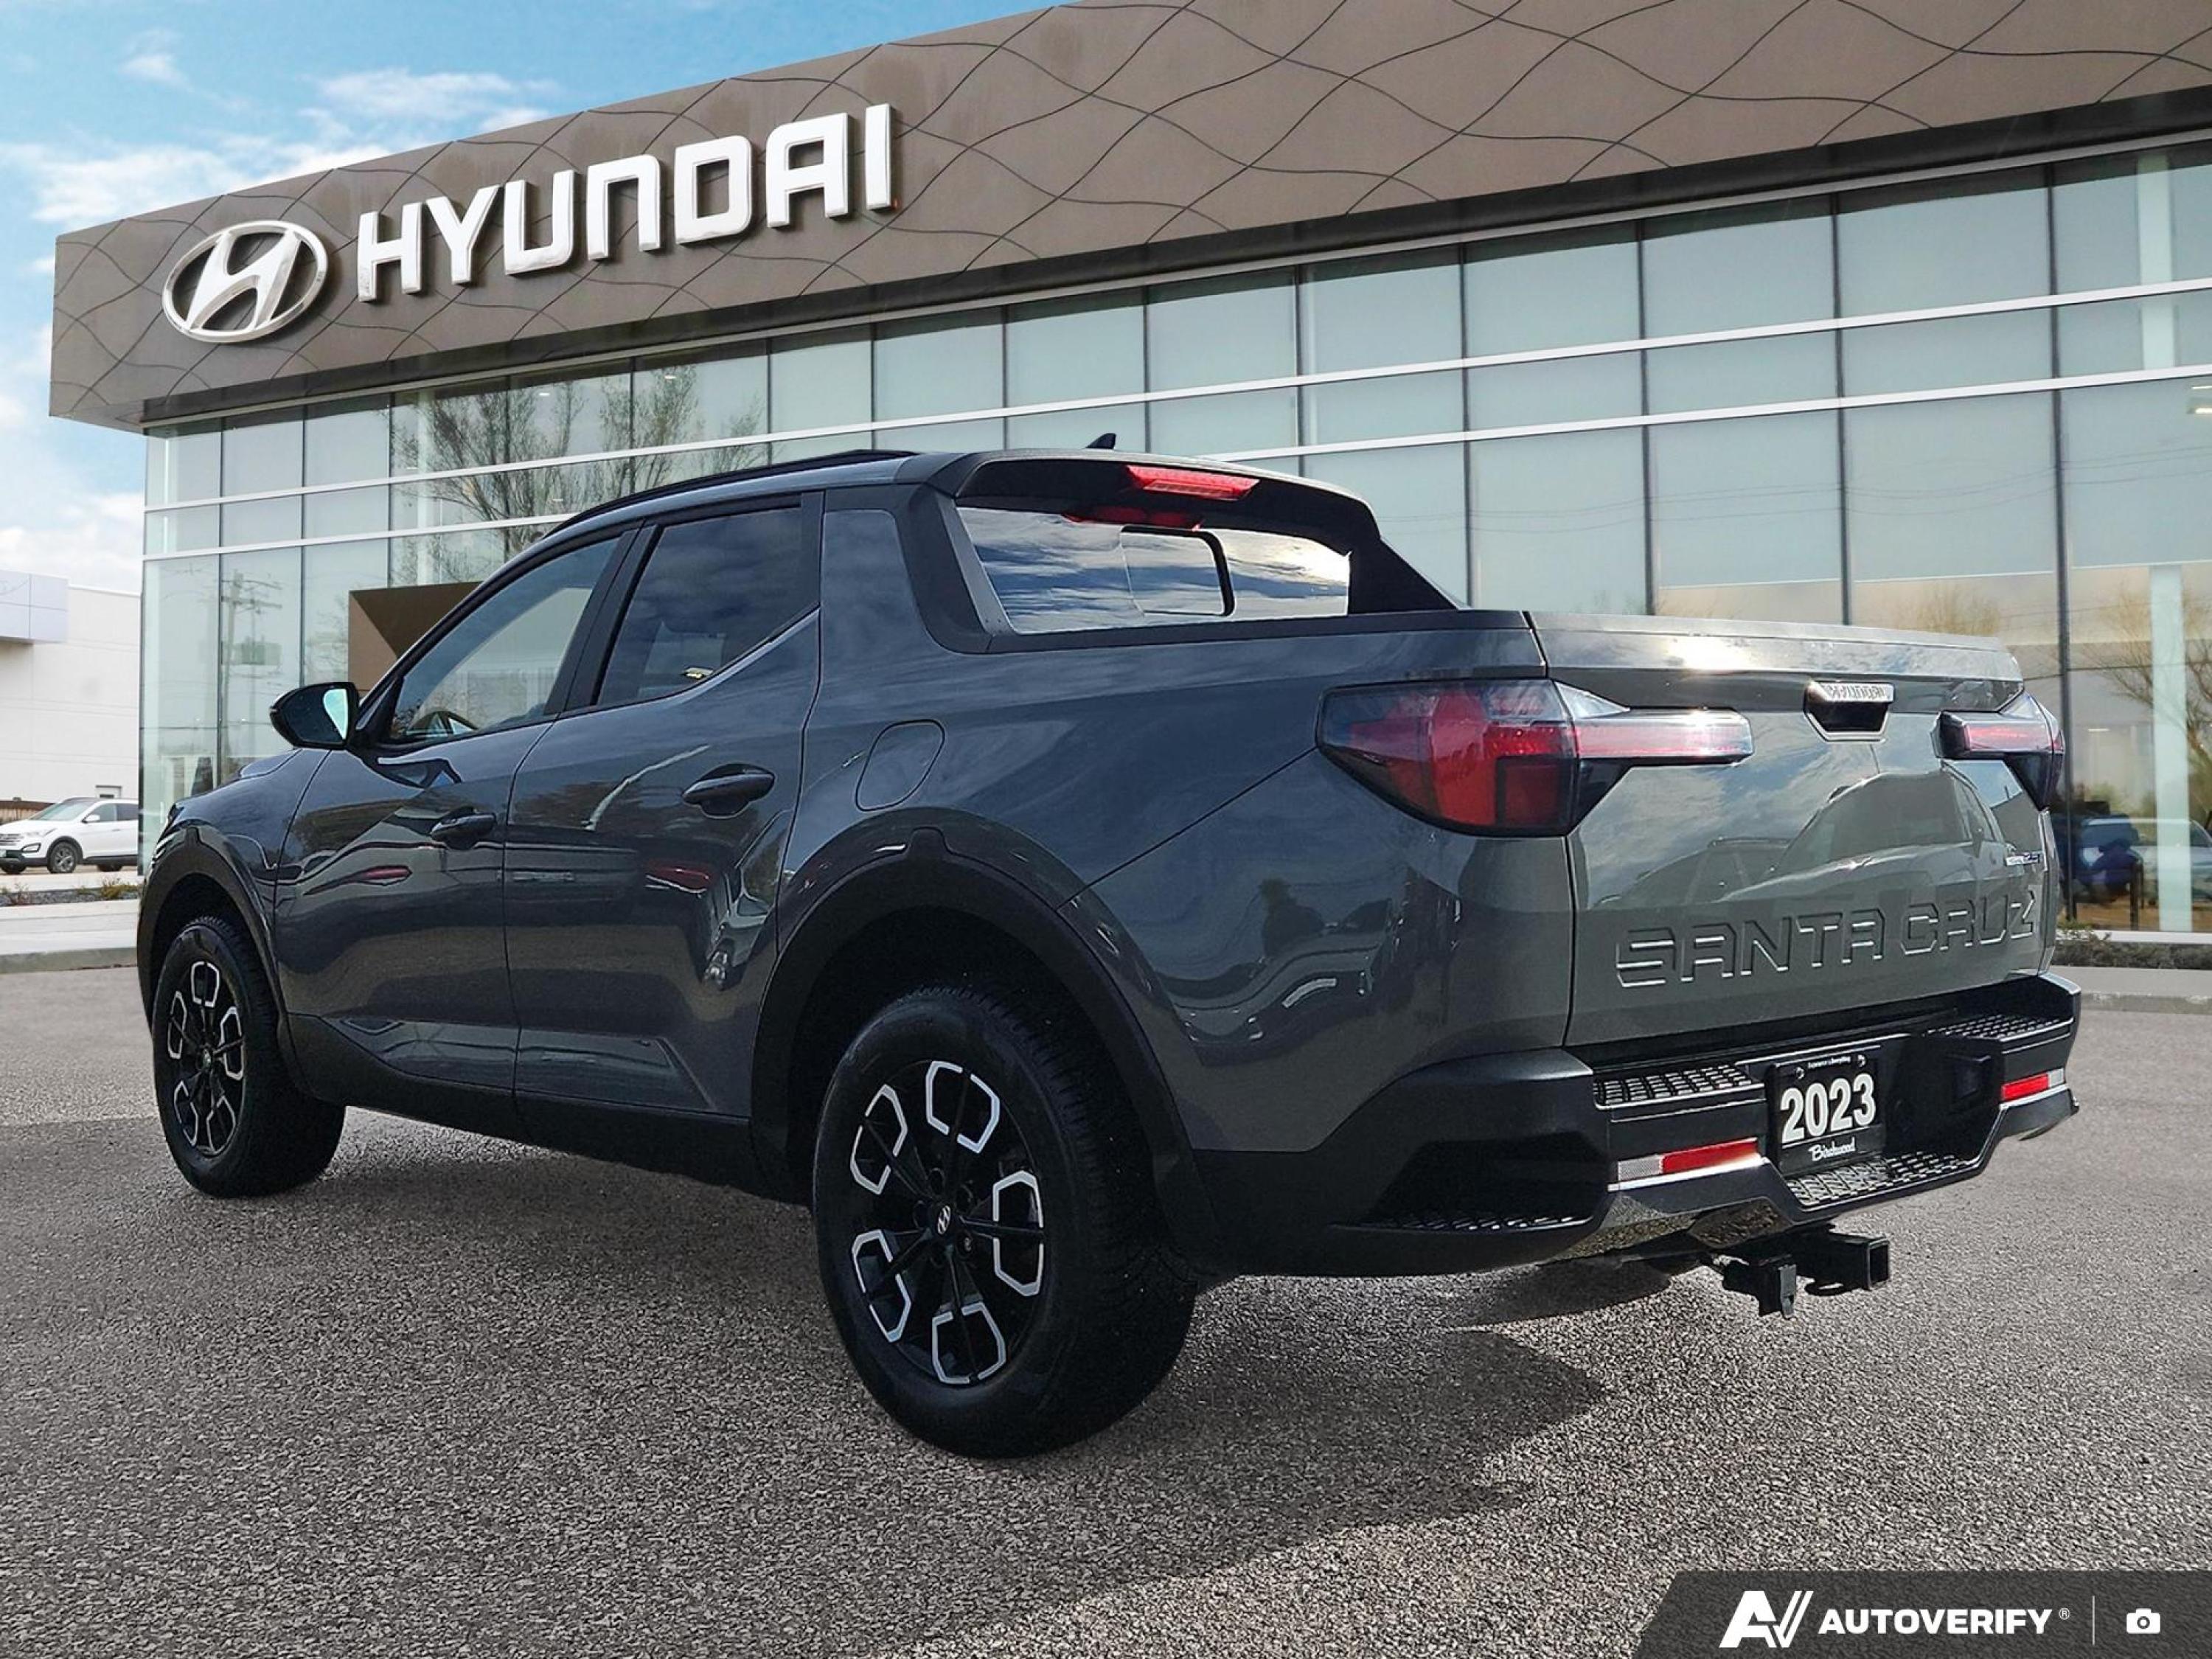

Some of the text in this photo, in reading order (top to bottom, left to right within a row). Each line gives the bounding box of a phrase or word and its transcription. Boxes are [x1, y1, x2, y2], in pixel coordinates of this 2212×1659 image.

[358, 103, 894, 302] HYUNDAI
[1616, 890, 2034, 987] SANTA CRUZ
[1780, 1073, 1877, 1144] 2023
